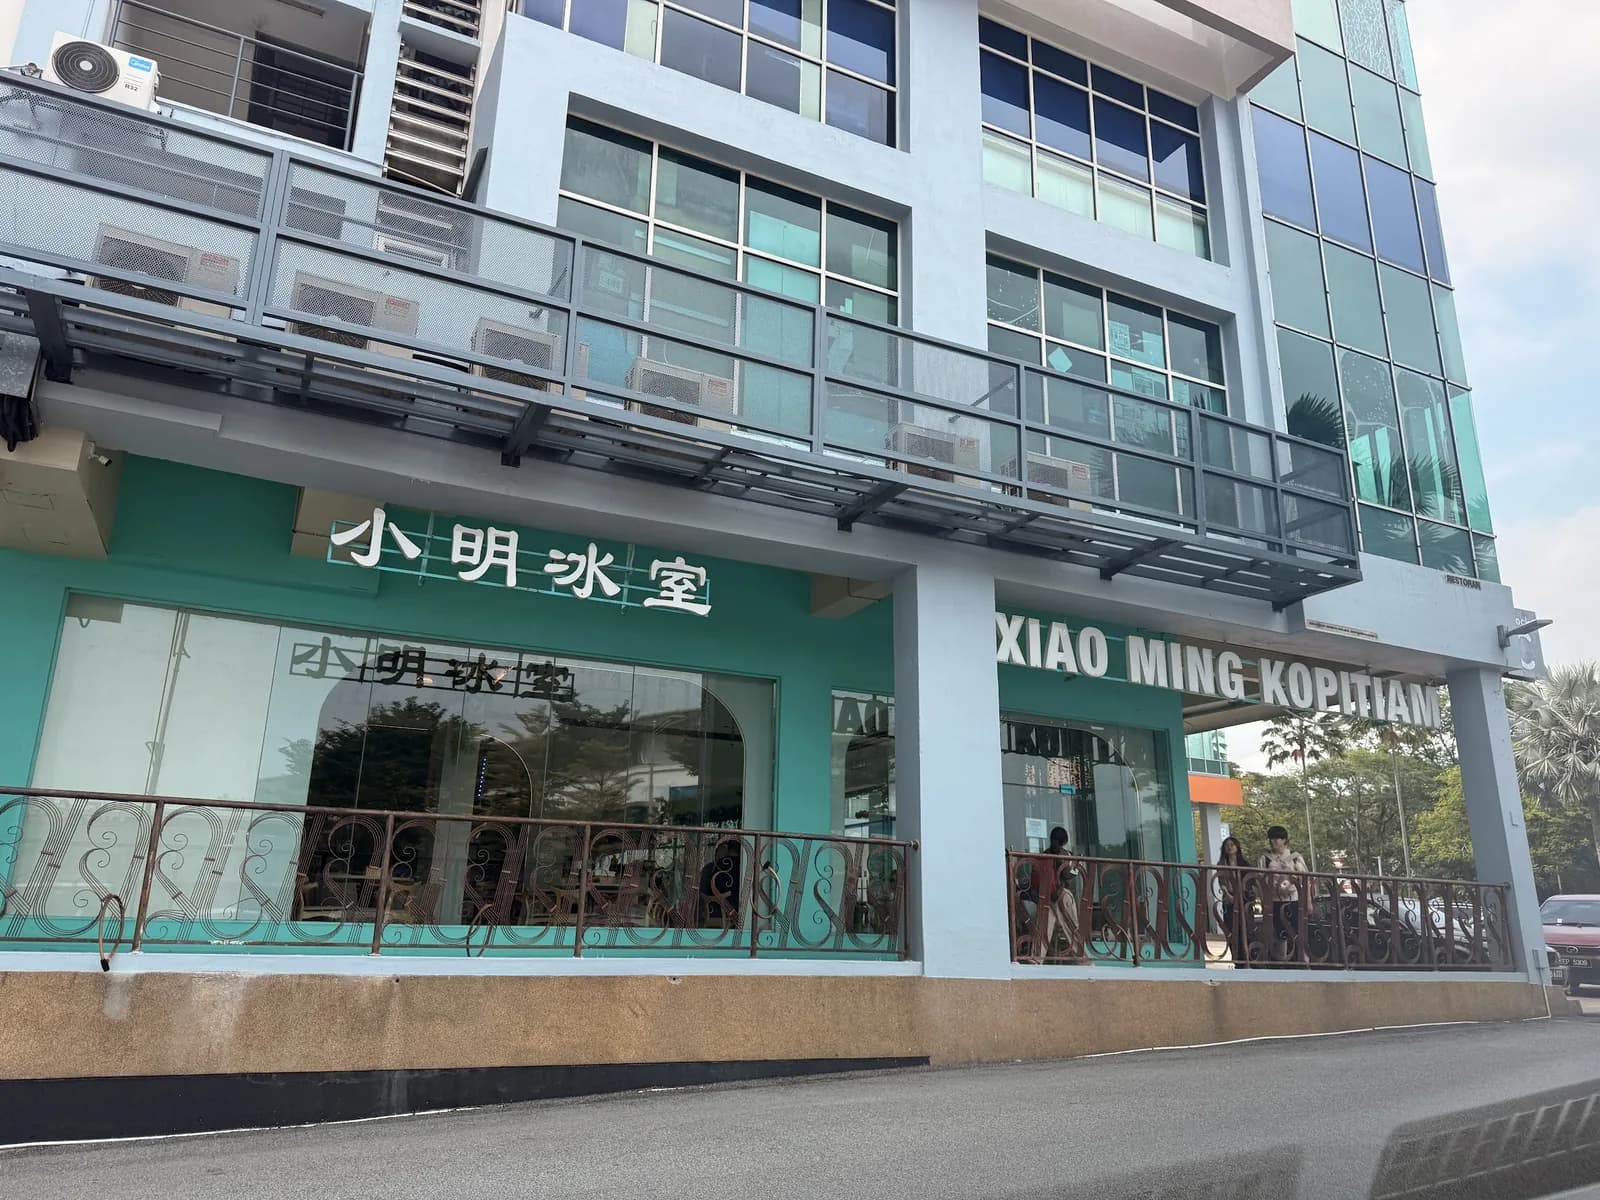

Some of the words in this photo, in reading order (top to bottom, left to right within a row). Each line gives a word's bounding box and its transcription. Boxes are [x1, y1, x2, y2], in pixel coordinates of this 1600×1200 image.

[331, 508, 712, 616] 小明冰室
[1447, 575, 1481, 590] RESTORAN
[994, 612, 1108, 678] XIAO
[1126, 635, 1245, 700] MING
[1260, 658, 1441, 729] KOPITIAM
